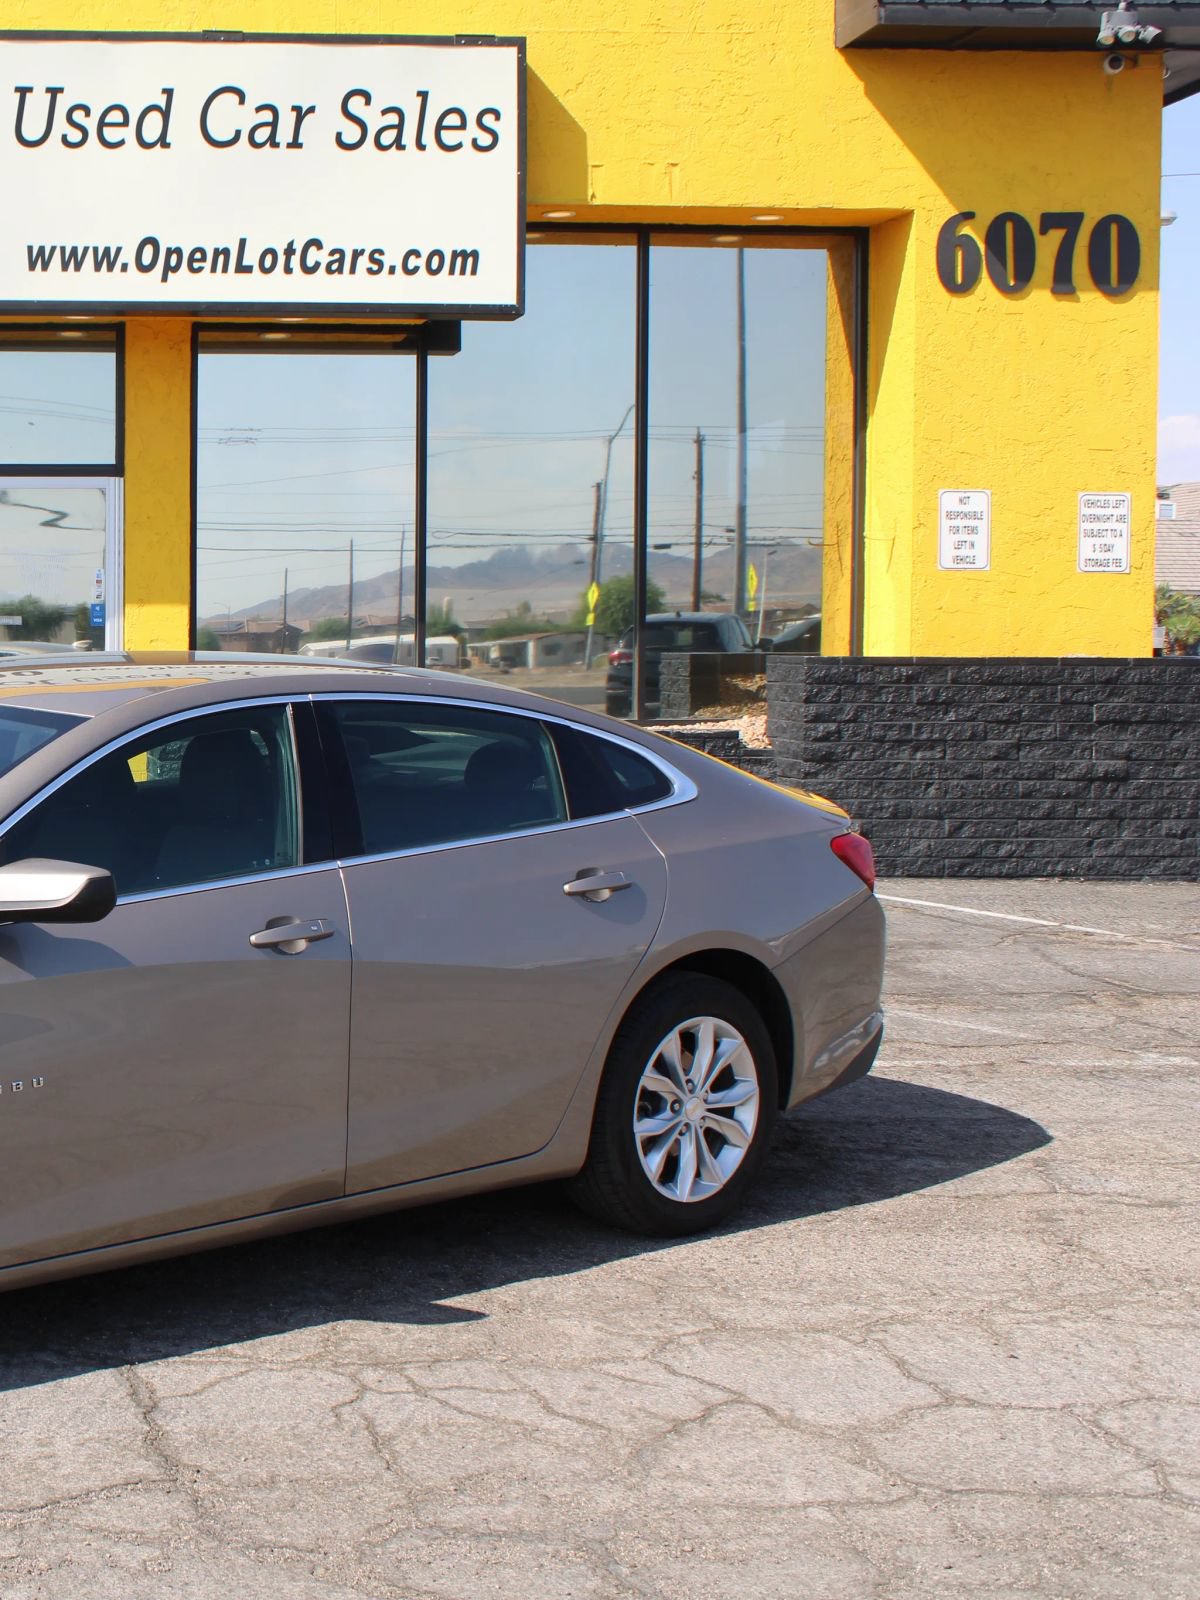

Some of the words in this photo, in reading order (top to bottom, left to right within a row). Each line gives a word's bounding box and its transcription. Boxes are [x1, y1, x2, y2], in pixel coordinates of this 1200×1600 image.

[13, 86, 174, 149] Used
[199, 86, 315, 149] Car
[334, 88, 501, 153] Sales
[936, 211, 1141, 295] 6070
[26, 236, 480, 282] www.OpenLotCars.com
[958, 496, 971, 505] NOT
[1083, 499, 1111, 509] VEHICLES
[1112, 499, 1126, 509] LEFT
[945, 511, 984, 520] RESPONSIBLE
[1081, 513, 1114, 523] OVERNIGHT
[1116, 514, 1127, 523] ARE
[948, 525, 960, 535] FOR
[961, 525, 979, 535] ITEMS
[1083, 528, 1109, 538] SUBJECT
[1110, 528, 1118, 538] TO
[953, 540, 968, 550] LEFT
[969, 540, 975, 550] IN
[952, 555, 976, 565] VEHICLE
[1084, 558, 1111, 568] STORAGE
[1112, 558, 1123, 568] FEE
